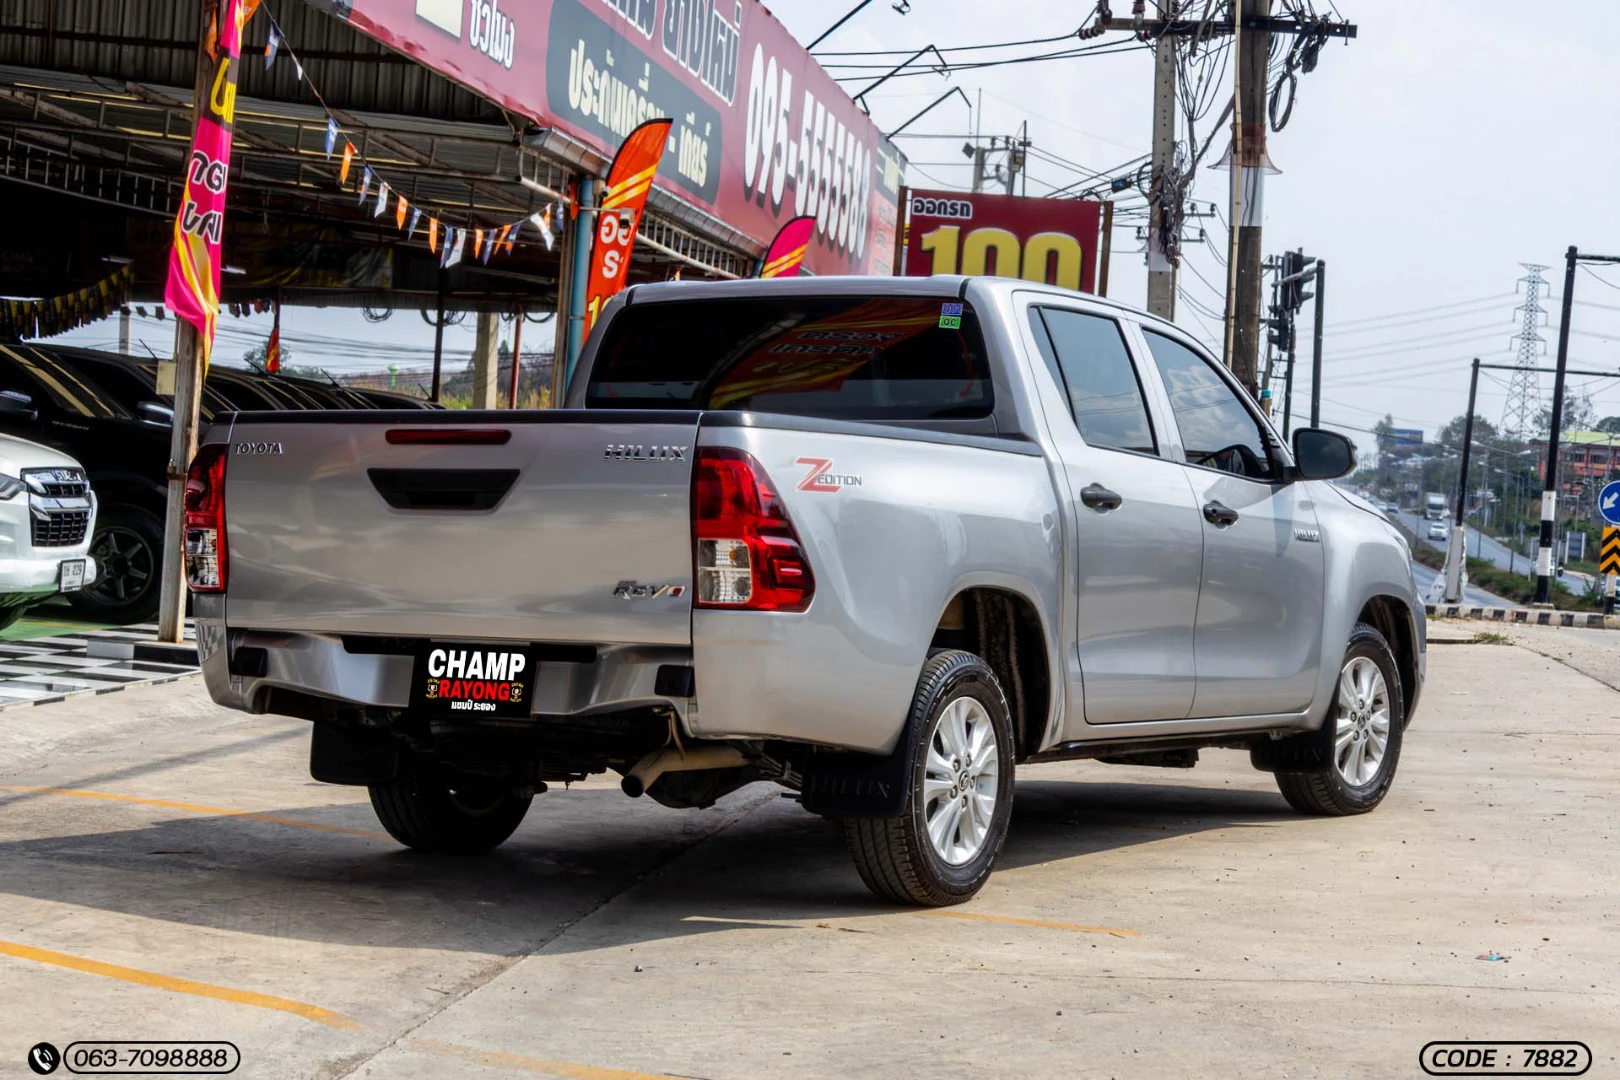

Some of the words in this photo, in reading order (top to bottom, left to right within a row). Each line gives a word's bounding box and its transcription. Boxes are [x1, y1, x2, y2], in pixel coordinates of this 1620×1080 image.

[568, 38, 666, 140] ประกันเครื่
[744, 43, 872, 260] 095-5555588
[913, 197, 972, 218] ออกรถ
[235, 442, 284, 455] TOYOTA
[603, 444, 688, 462] HILUX
[795, 457, 844, 492] Z
[817, 474, 862, 486] EDITION
[428, 648, 526, 682] CHAMP
[438, 679, 511, 701] RAYONG
